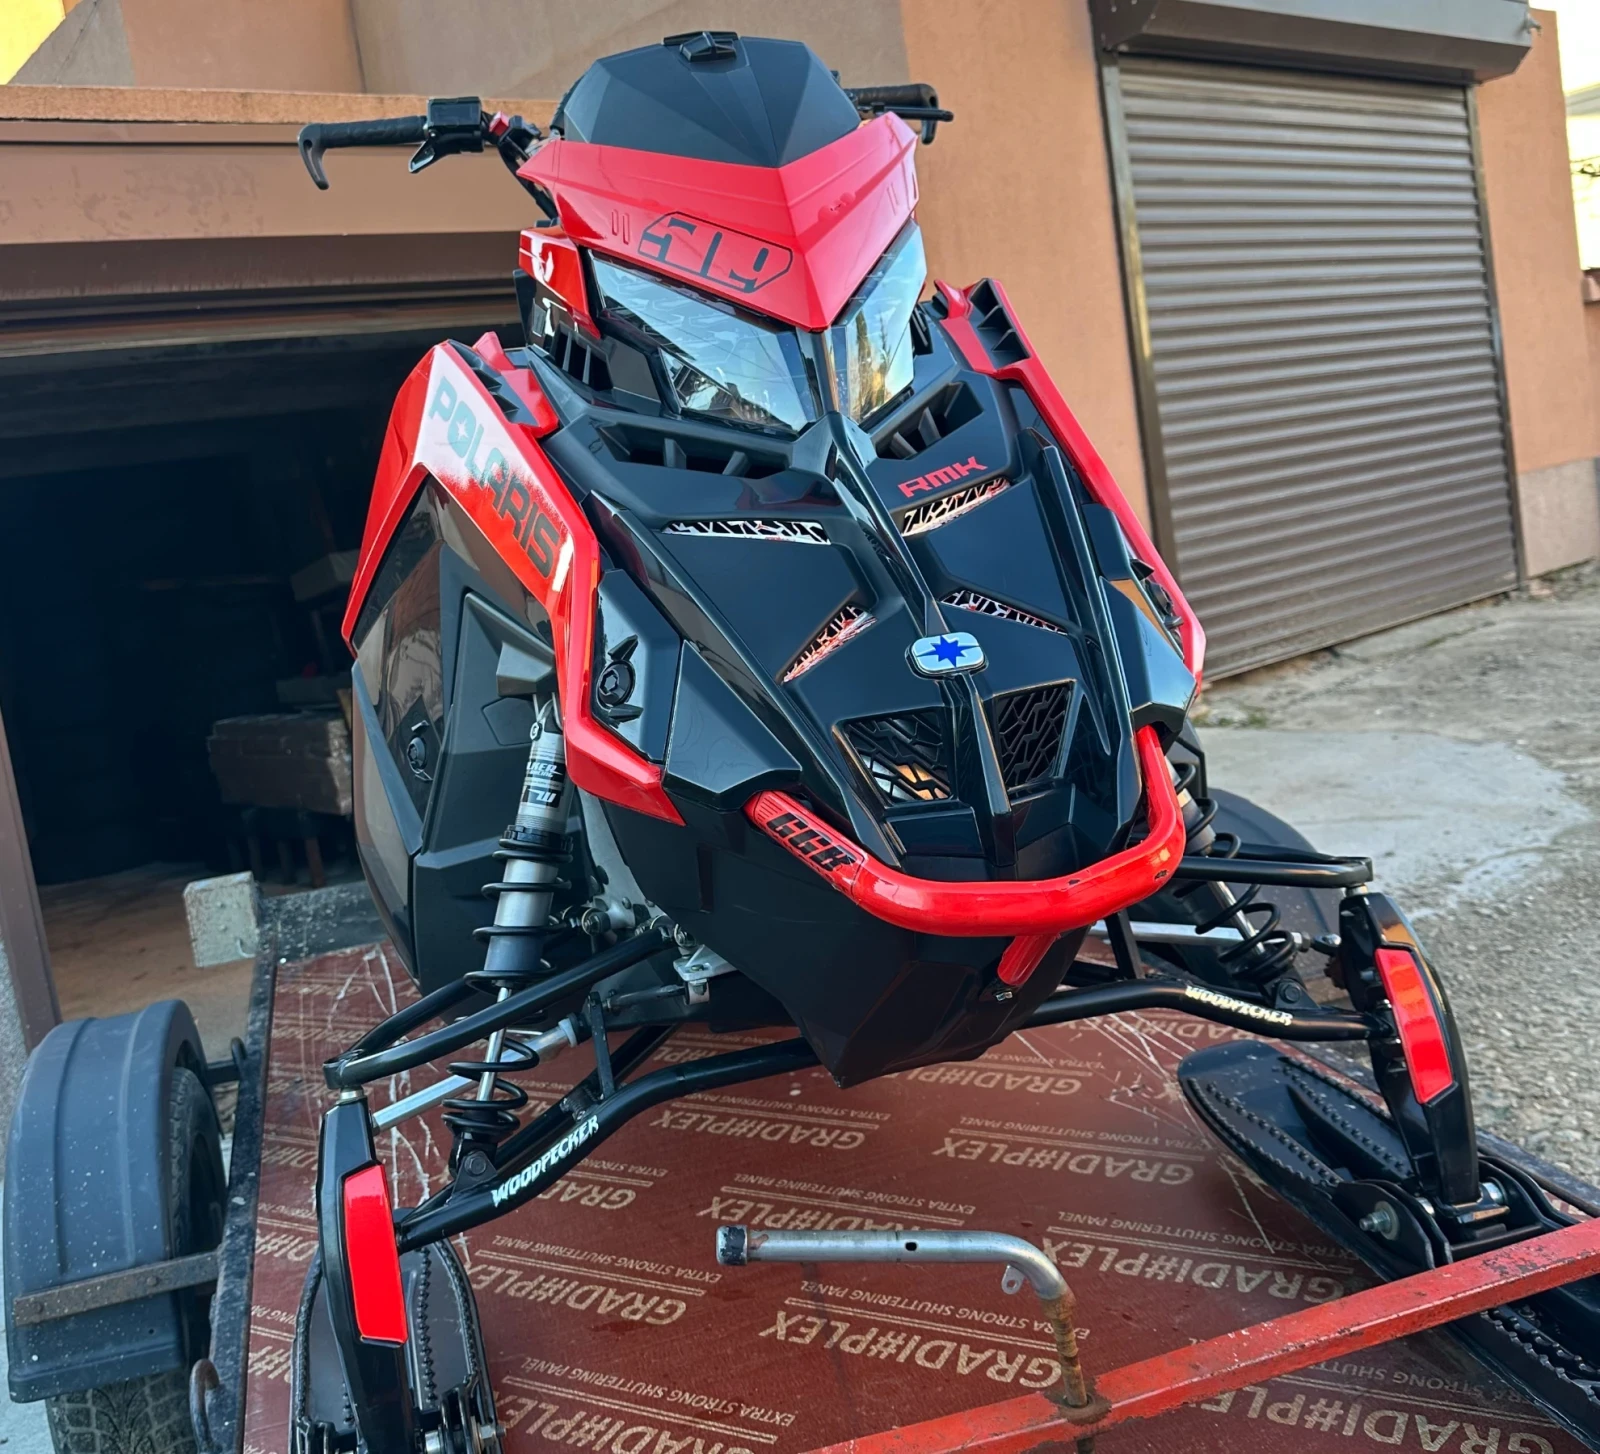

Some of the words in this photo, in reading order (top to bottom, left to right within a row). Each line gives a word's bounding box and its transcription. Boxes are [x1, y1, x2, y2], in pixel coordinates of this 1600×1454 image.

[427, 375, 561, 580] POLARIS
[898, 456, 988, 498] RMK
[797, 1103, 849, 1116] STRONG
[850, 1109, 892, 1121] EXTRA
[649, 1109, 866, 1150] GRADI#PLEX
[959, 1116, 1002, 1130] PANEL
[1002, 1121, 1096, 1138] SHUTTERING
[491, 1115, 599, 1208] WOODPECKER
[631, 1163, 669, 1177] EXTRA
[931, 1138, 1195, 1185] GRADI#PLEX
[734, 1173, 776, 1188] PANEL
[775, 1179, 864, 1199] SHUTTERING
[864, 1191, 926, 1208] STRONG
[928, 1200, 976, 1215] EXTRA
[1058, 1211, 1108, 1228] PANEL
[1110, 1218, 1221, 1244] SHUTTERING
[492, 1235, 530, 1251] PANEL
[1222, 1233, 1298, 1254] STRONG
[532, 1243, 617, 1266] SHUTTERING
[615, 1257, 674, 1276] STRONG
[675, 1266, 723, 1284] EXTRA
[799, 1280, 848, 1298] PANEL
[848, 1289, 955, 1317] SHUTTERING
[955, 1307, 1030, 1330] STRONG
[759, 1311, 1063, 1388] GRADI#PLEX
[521, 1356, 569, 1377] PANEL
[569, 1367, 669, 1399] SHUTTERING
[666, 1390, 739, 1415] STRONG
[740, 1403, 797, 1427] EXTRA
